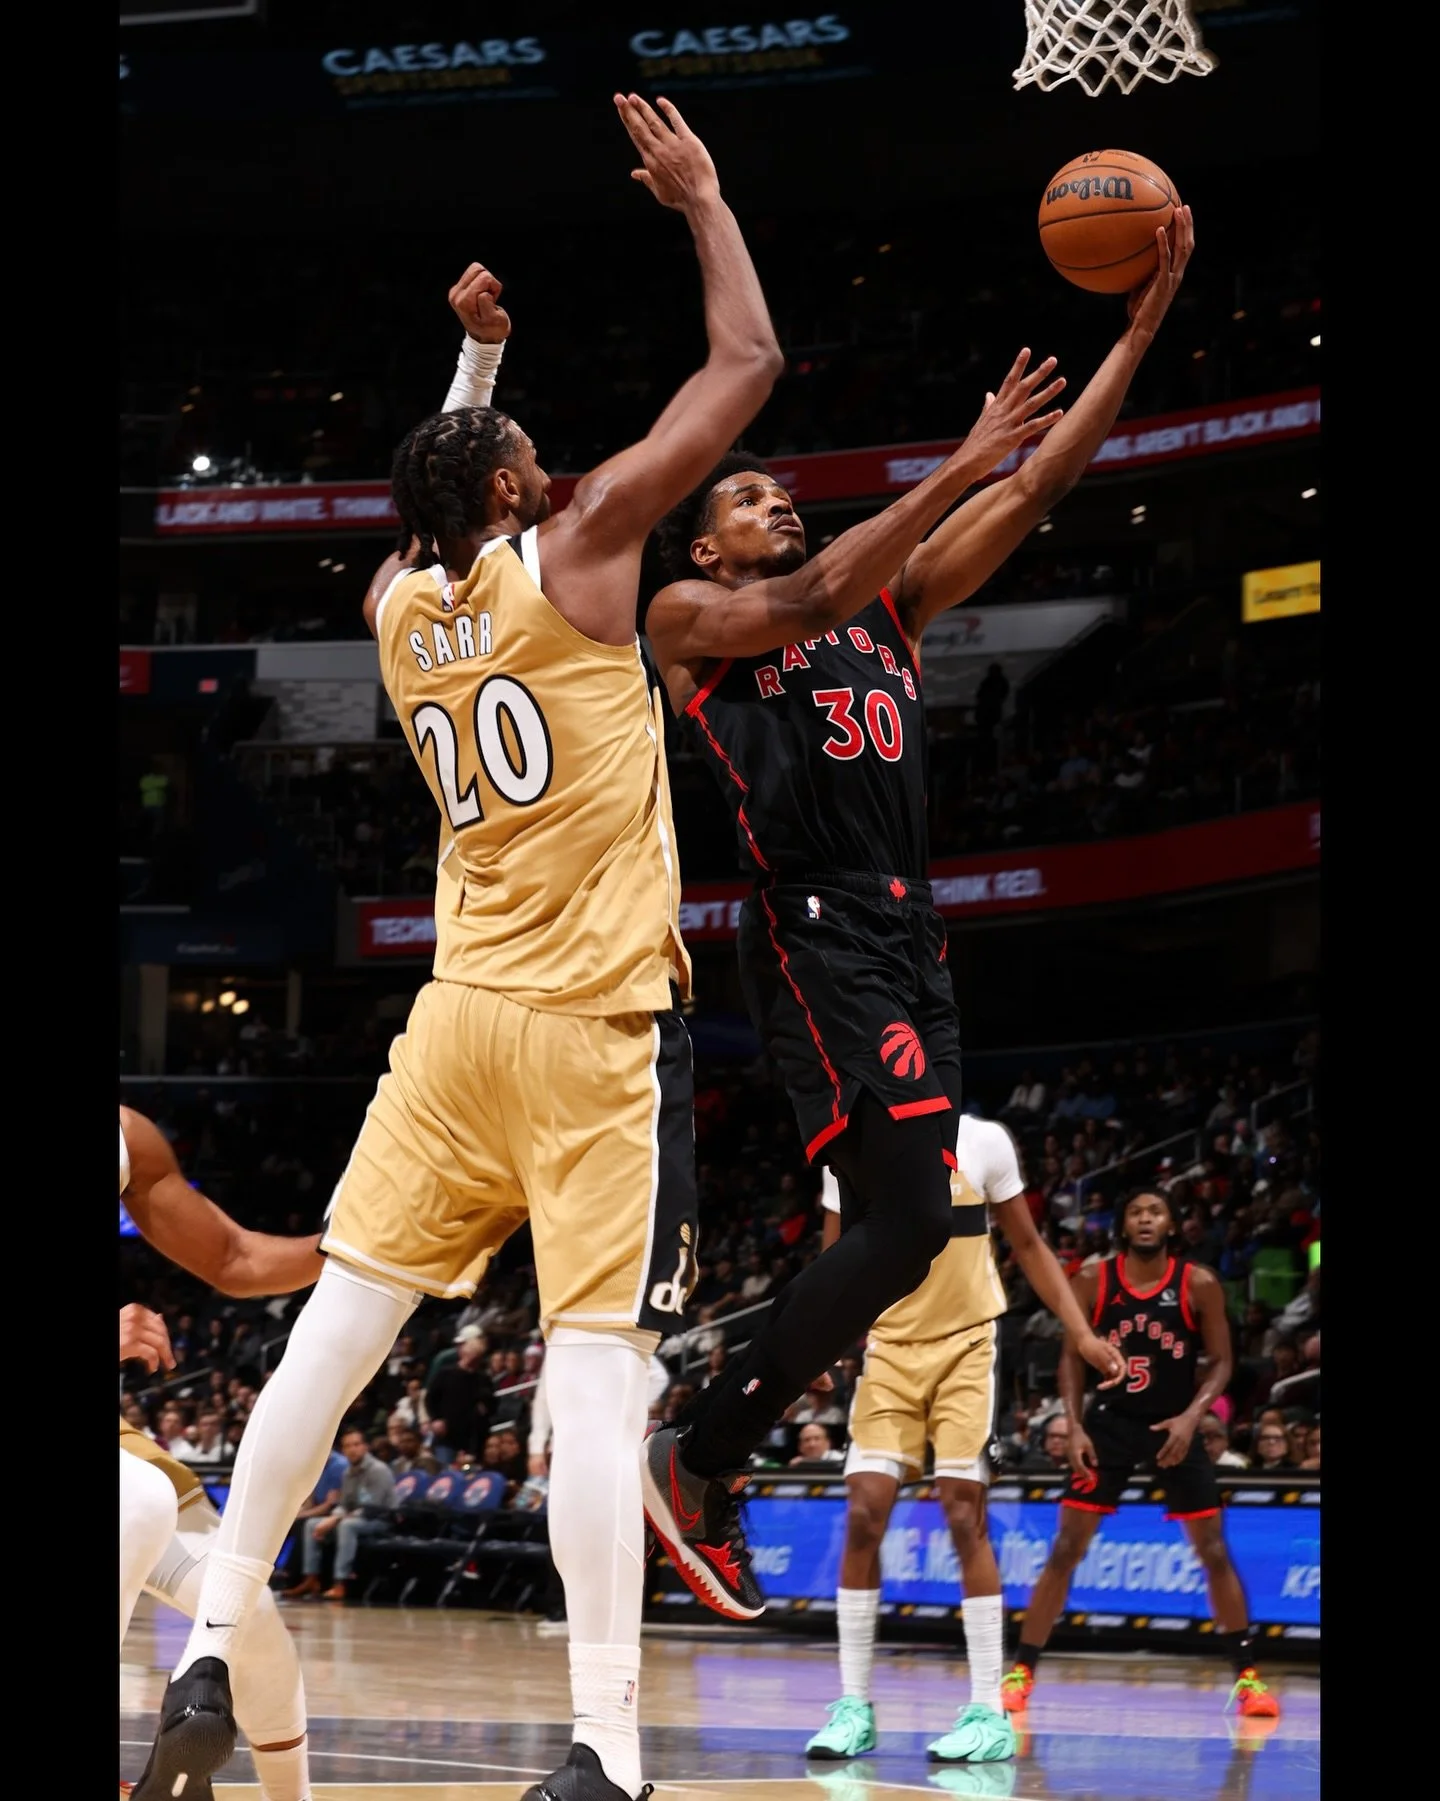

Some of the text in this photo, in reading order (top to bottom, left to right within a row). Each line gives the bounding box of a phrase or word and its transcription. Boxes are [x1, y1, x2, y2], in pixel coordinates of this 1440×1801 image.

[322, 36, 547, 76] CAESARS
[629, 14, 850, 57] CAESARS
[1046, 175, 1135, 206] Wilson
[409, 611, 493, 672] SARR
[812, 687, 904, 762] 30
[411, 673, 554, 832] 20
[1107, 1313, 1185, 1359] APTORS
[1126, 1355, 1151, 1393] 5
